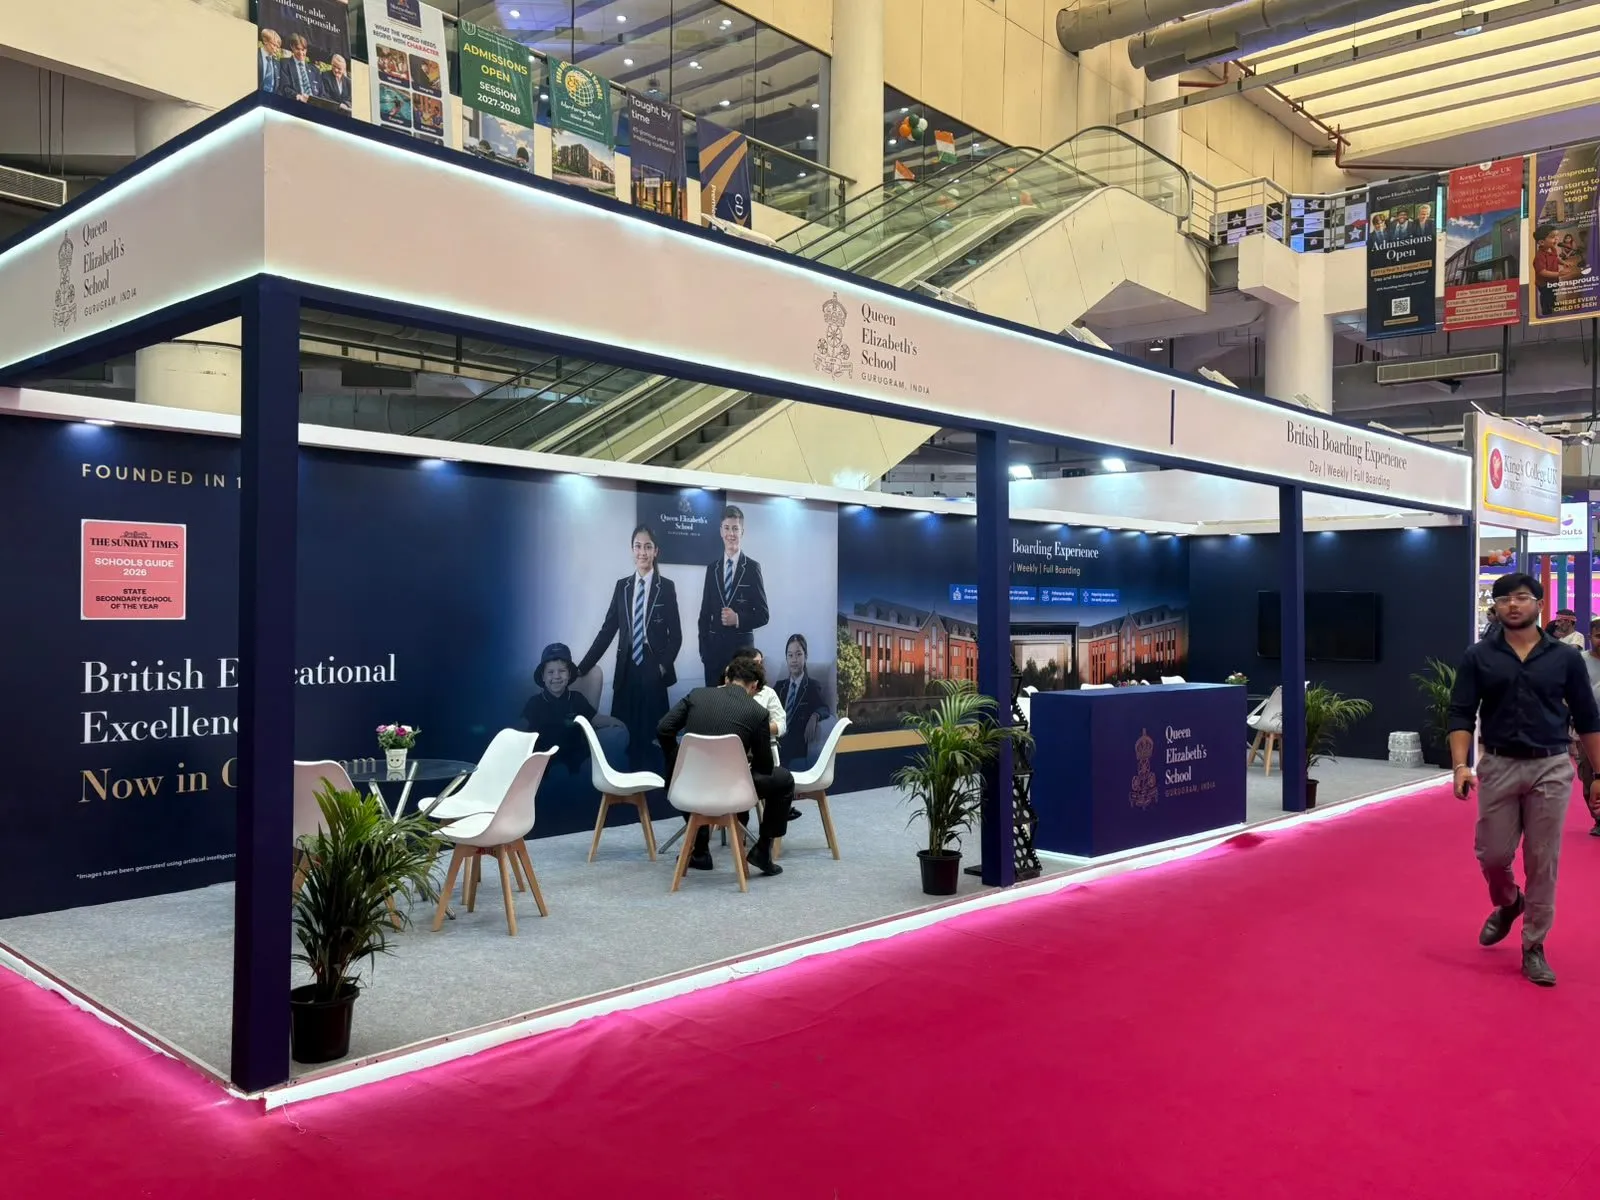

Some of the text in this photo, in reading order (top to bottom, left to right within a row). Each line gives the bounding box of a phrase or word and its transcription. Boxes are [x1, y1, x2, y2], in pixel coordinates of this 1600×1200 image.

[295, 13, 341, 33] responsible
[308, 8, 326, 20] able
[406, 41, 440, 56] CHARACTER
[463, 43, 528, 75] ADMISSIONS
[481, 64, 511, 83] OPEN
[480, 81, 517, 102] SESSION
[477, 93, 521, 115] 2027-2028
[630, 94, 672, 121] Taught by
[631, 110, 651, 124] time
[1539, 185, 1563, 195] Ayaan
[1564, 180, 1589, 190] starts
[1546, 179, 1559, 187] shy
[1583, 185, 1598, 193] the
[1564, 194, 1589, 203] stage
[82, 220, 108, 247] Queen
[1371, 234, 1433, 252] Admissions
[83, 237, 125, 273] Elizabeth's
[1386, 248, 1416, 262] Open
[83, 269, 110, 298] School
[1547, 276, 1599, 288] beansprouts
[120, 287, 137, 302] INDIA
[861, 303, 896, 326] Queen
[861, 327, 918, 356] Elizabeth's
[861, 349, 897, 371] School
[861, 372, 930, 395] GURUGRAM, INDIA
[1286, 420, 1408, 470] British Boarding Experience
[82, 463, 193, 485] FOUNDED
[205, 473, 225, 488] IN
[1309, 460, 1322, 477] Day
[1327, 464, 1349, 482] Weekly
[1353, 469, 1365, 482] Full
[1365, 472, 1391, 490] Boarding
[660, 513, 708, 524] Queen Elizabeth's
[675, 522, 694, 530] School
[90, 537, 179, 549] THE SUNDAY TIMES
[1012, 537, 1099, 561] Boarding Experience
[94, 557, 174, 568] SCHOOLS GUIDE
[123, 568, 147, 576] 2026
[1016, 562, 1038, 575] Weekly
[1043, 564, 1054, 574] Full
[1055, 565, 1081, 577] Boarding
[81, 653, 397, 694] British Eational
[80, 706, 239, 745] Excellen
[1165, 725, 1191, 744] Queen
[1166, 744, 1207, 764] Elizabeth's
[78, 768, 164, 803] Now
[175, 762, 209, 794] in
[1165, 765, 1192, 785] School
[135, 862, 166, 873] generated
[183, 856, 206, 865] artificial
